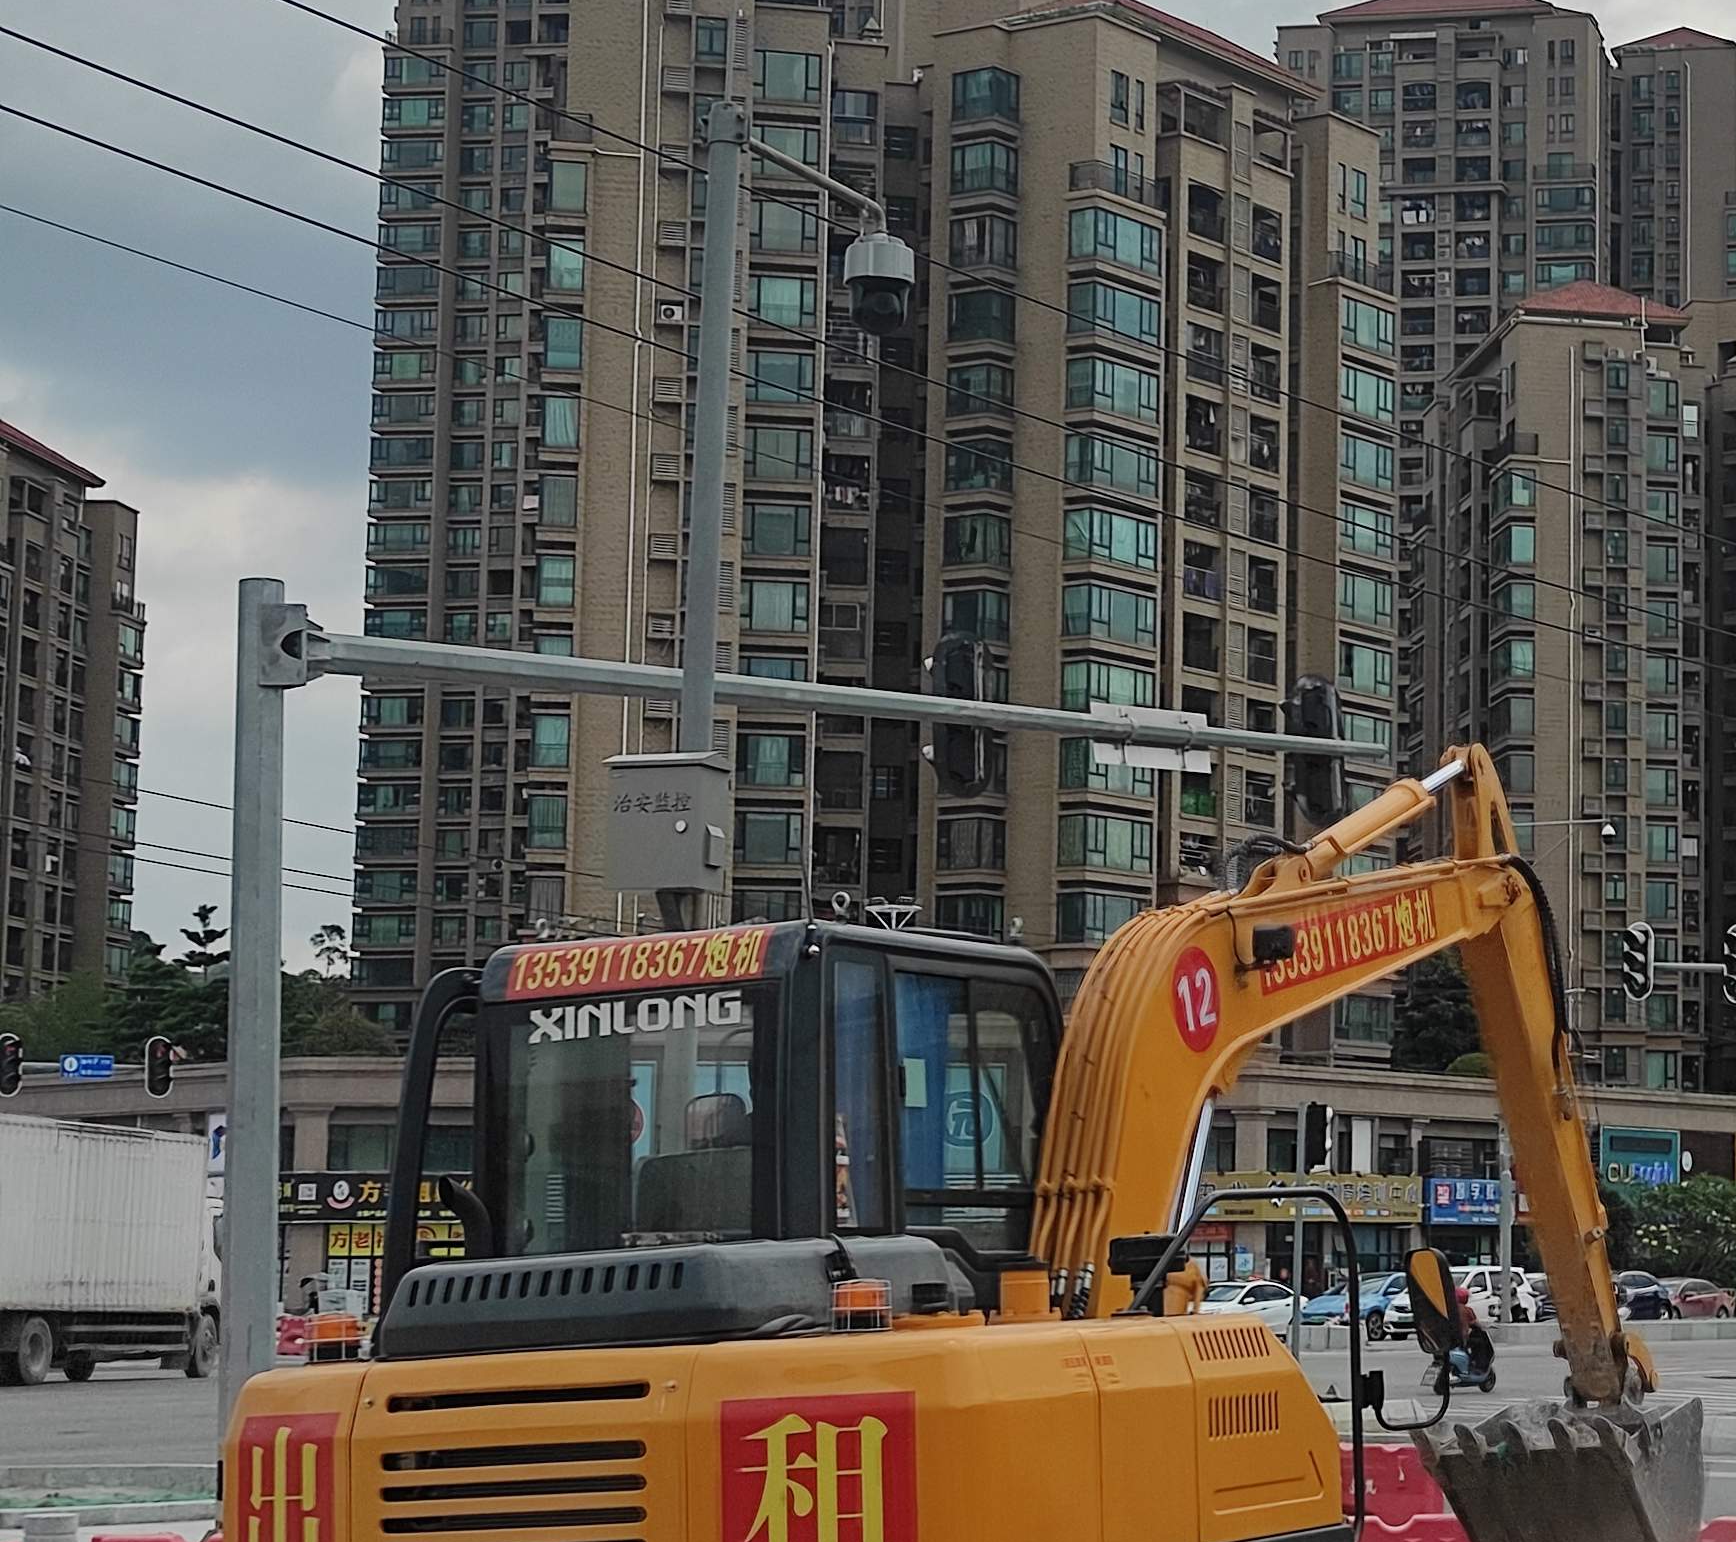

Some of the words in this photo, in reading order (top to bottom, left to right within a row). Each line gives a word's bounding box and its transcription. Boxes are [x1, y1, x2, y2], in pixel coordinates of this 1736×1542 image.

[613, 791, 692, 813] 治安监控
[513, 929, 765, 992] 13539118367炮机
[528, 989, 742, 1044] XINLONG
[1177, 967, 1217, 1031] 12
